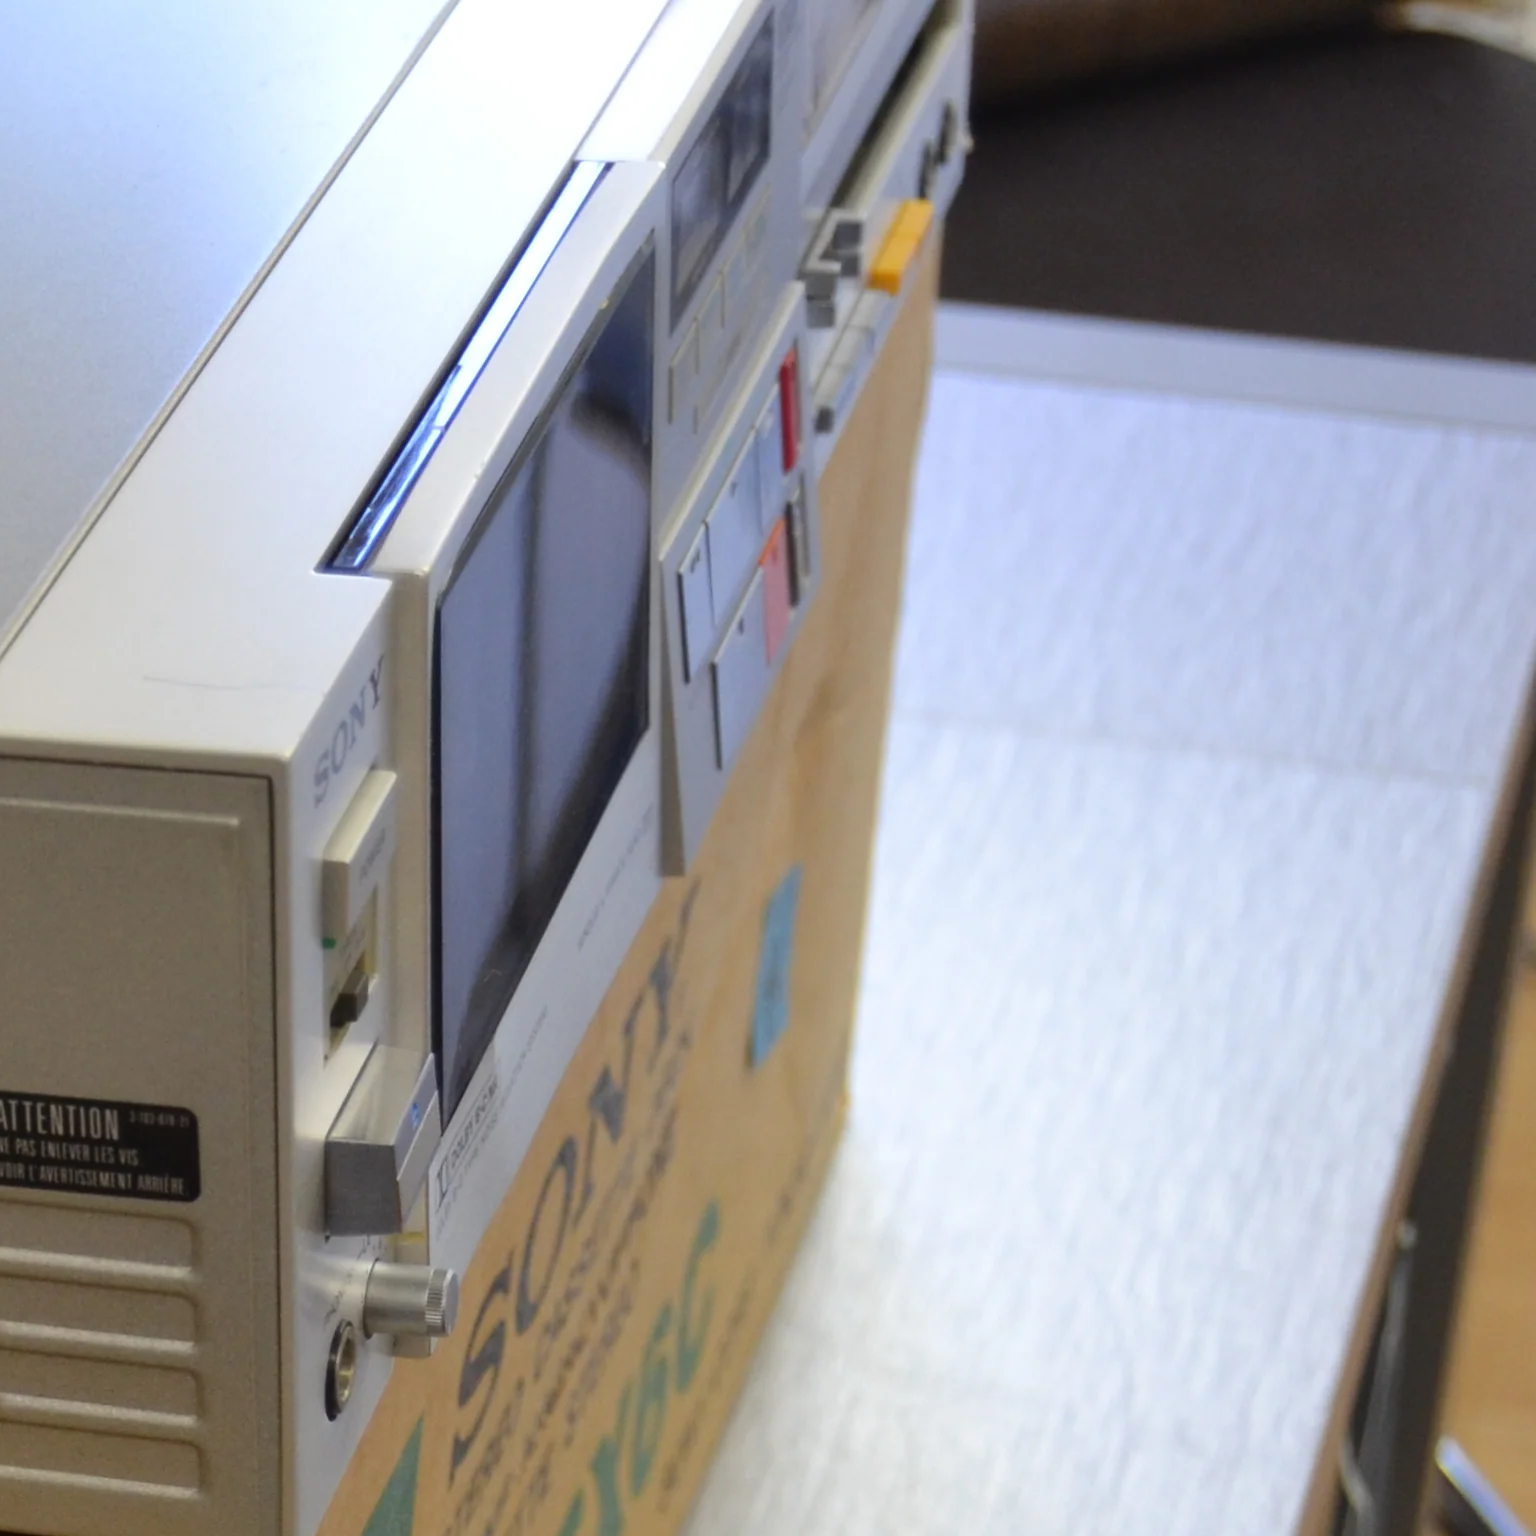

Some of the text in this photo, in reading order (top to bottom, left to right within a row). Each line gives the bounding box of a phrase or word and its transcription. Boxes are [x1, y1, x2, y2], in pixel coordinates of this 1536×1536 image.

[314, 654, 385, 810] SONY
[15, 1138, 36, 1158] PAS
[40, 1140, 90, 1162] ENLEVER
[94, 1146, 115, 1165] LES
[448, 875, 702, 1492] SONY
